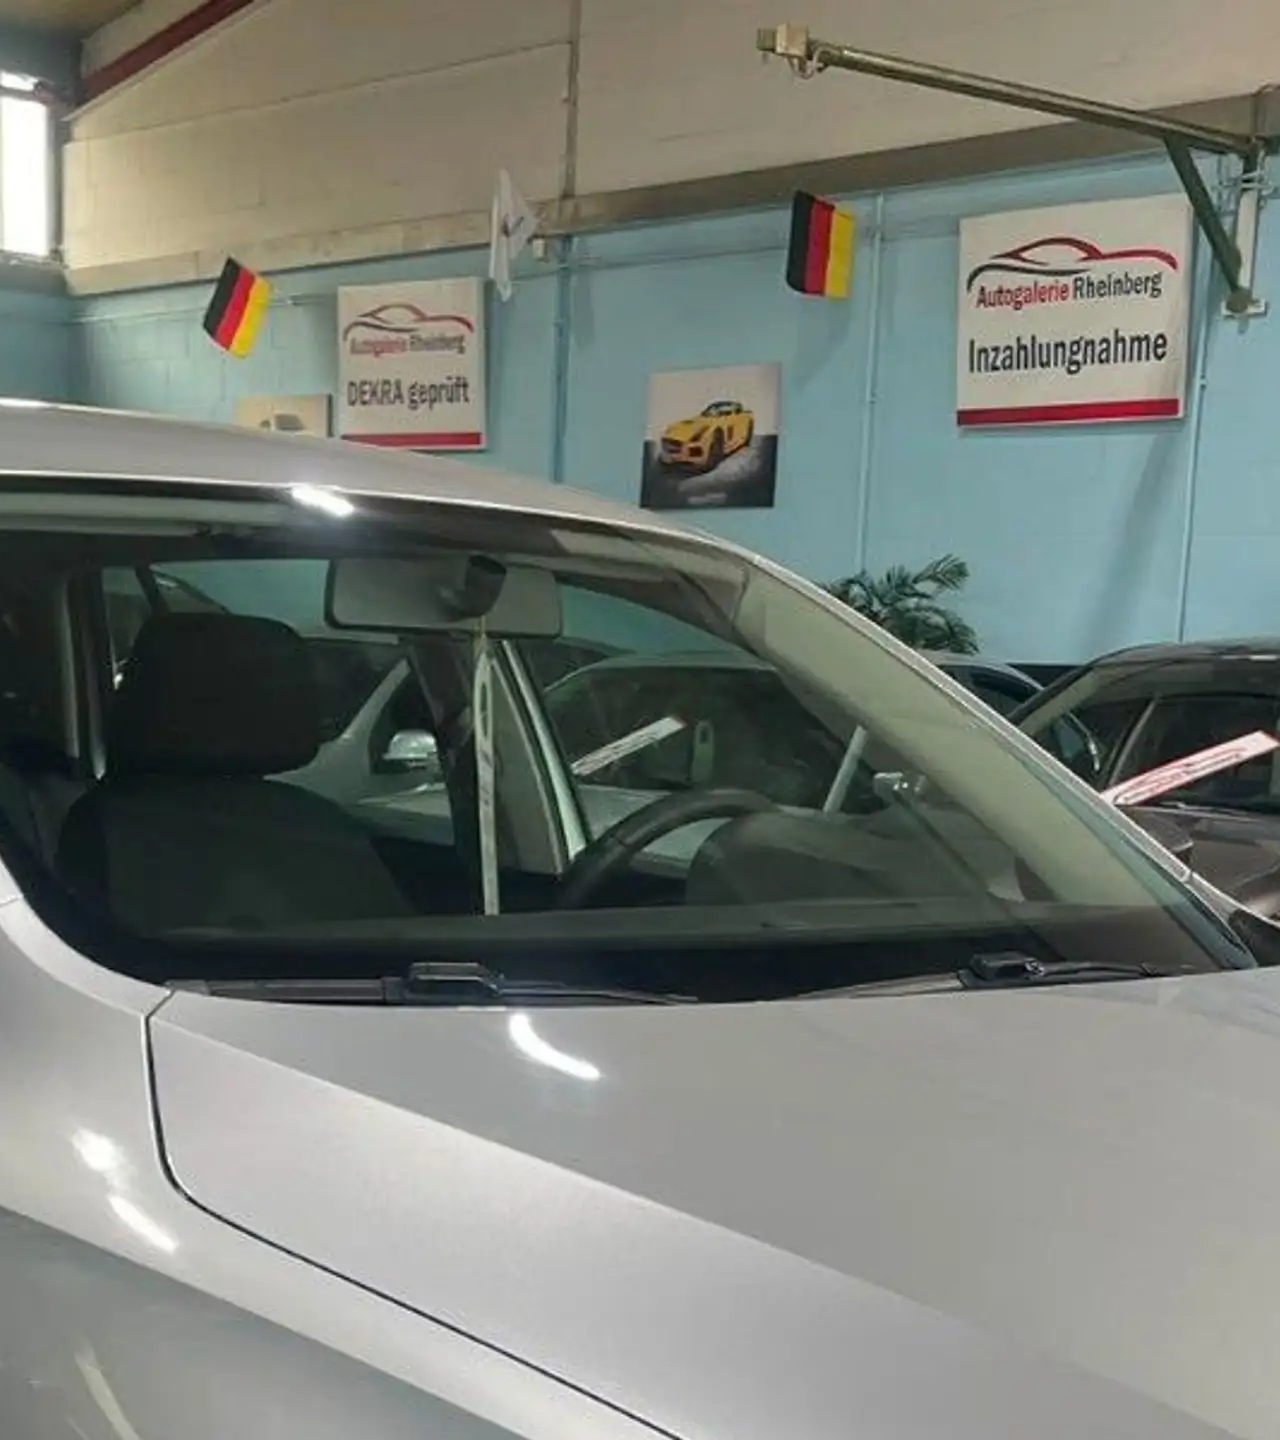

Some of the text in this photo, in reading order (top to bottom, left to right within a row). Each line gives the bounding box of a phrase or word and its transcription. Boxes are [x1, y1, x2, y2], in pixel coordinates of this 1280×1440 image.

[976, 271, 1163, 310] Autogalerie Rheinberg
[969, 327, 1168, 375] Inzahlungnahme
[347, 374, 470, 411] DEKRA geprüft
